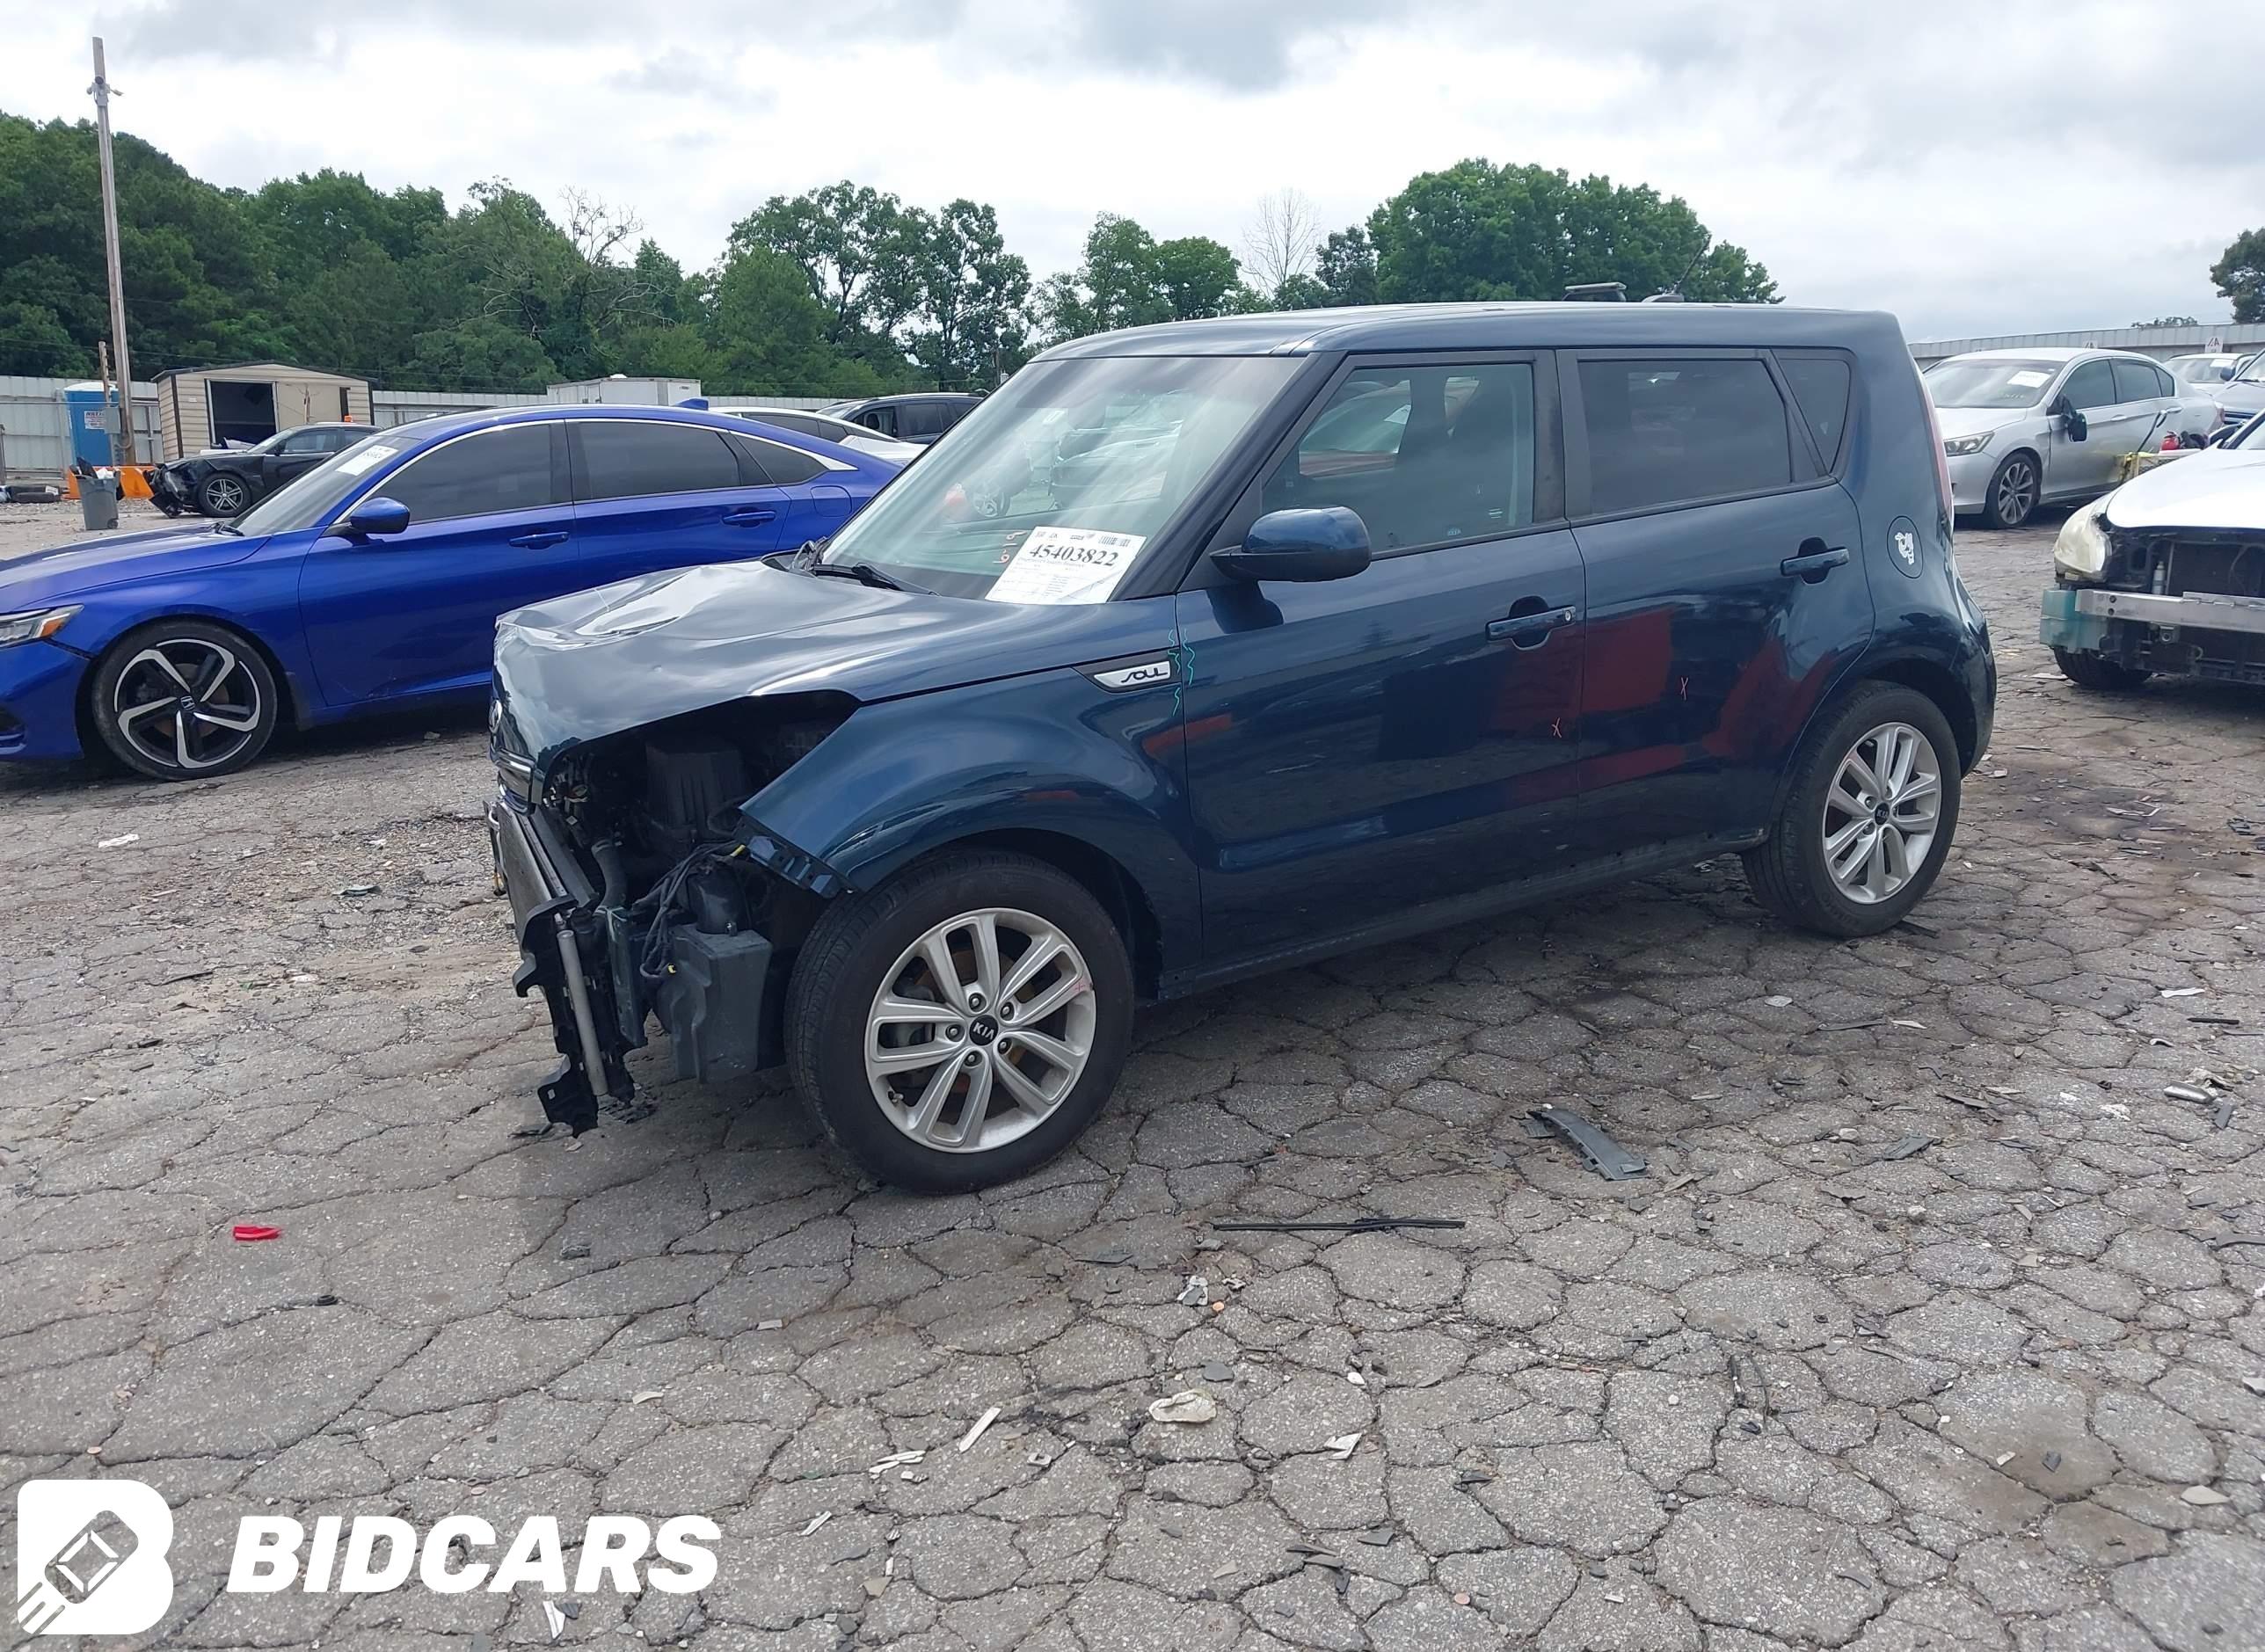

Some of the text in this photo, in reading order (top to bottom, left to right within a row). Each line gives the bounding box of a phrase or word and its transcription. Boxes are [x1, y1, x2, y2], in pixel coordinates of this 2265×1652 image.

[1029, 543, 1119, 567] 45403822
[1120, 667, 1169, 683] SOUL
[972, 1022, 994, 1040] KIA
